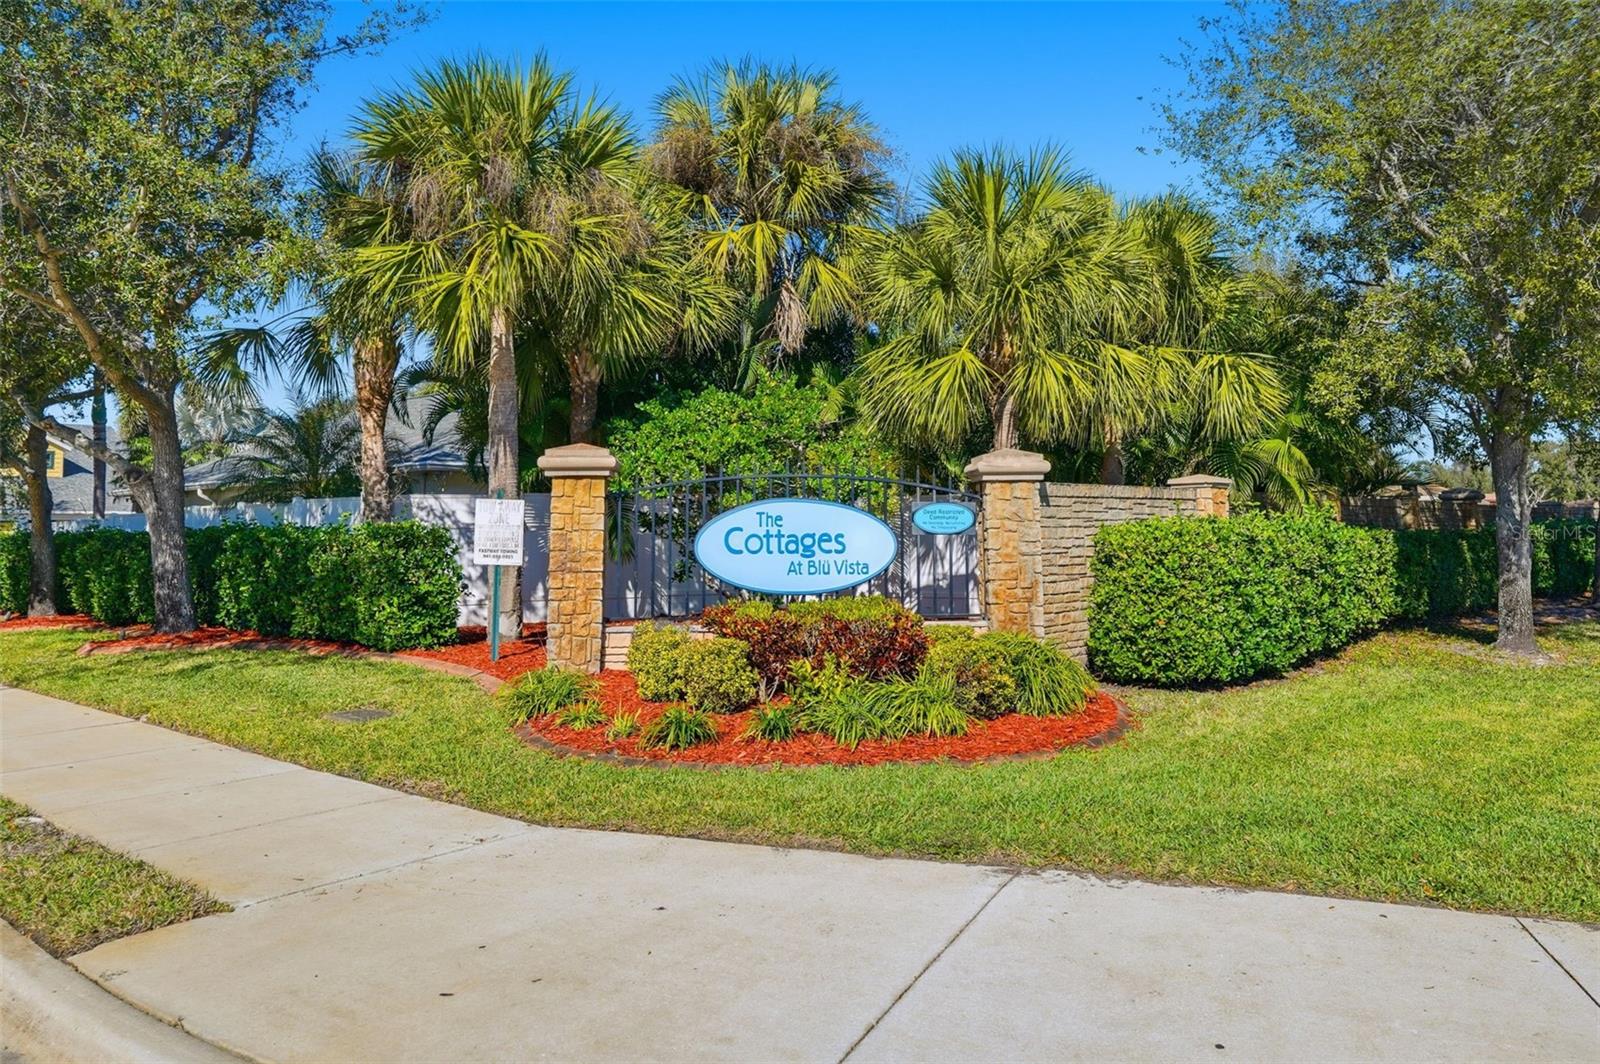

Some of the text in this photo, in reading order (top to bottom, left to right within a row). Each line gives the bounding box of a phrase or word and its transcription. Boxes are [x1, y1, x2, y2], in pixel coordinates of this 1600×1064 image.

[756, 511, 784, 528] The
[724, 526, 847, 559] Cottages
[786, 560, 870, 576] At Blü Vista
